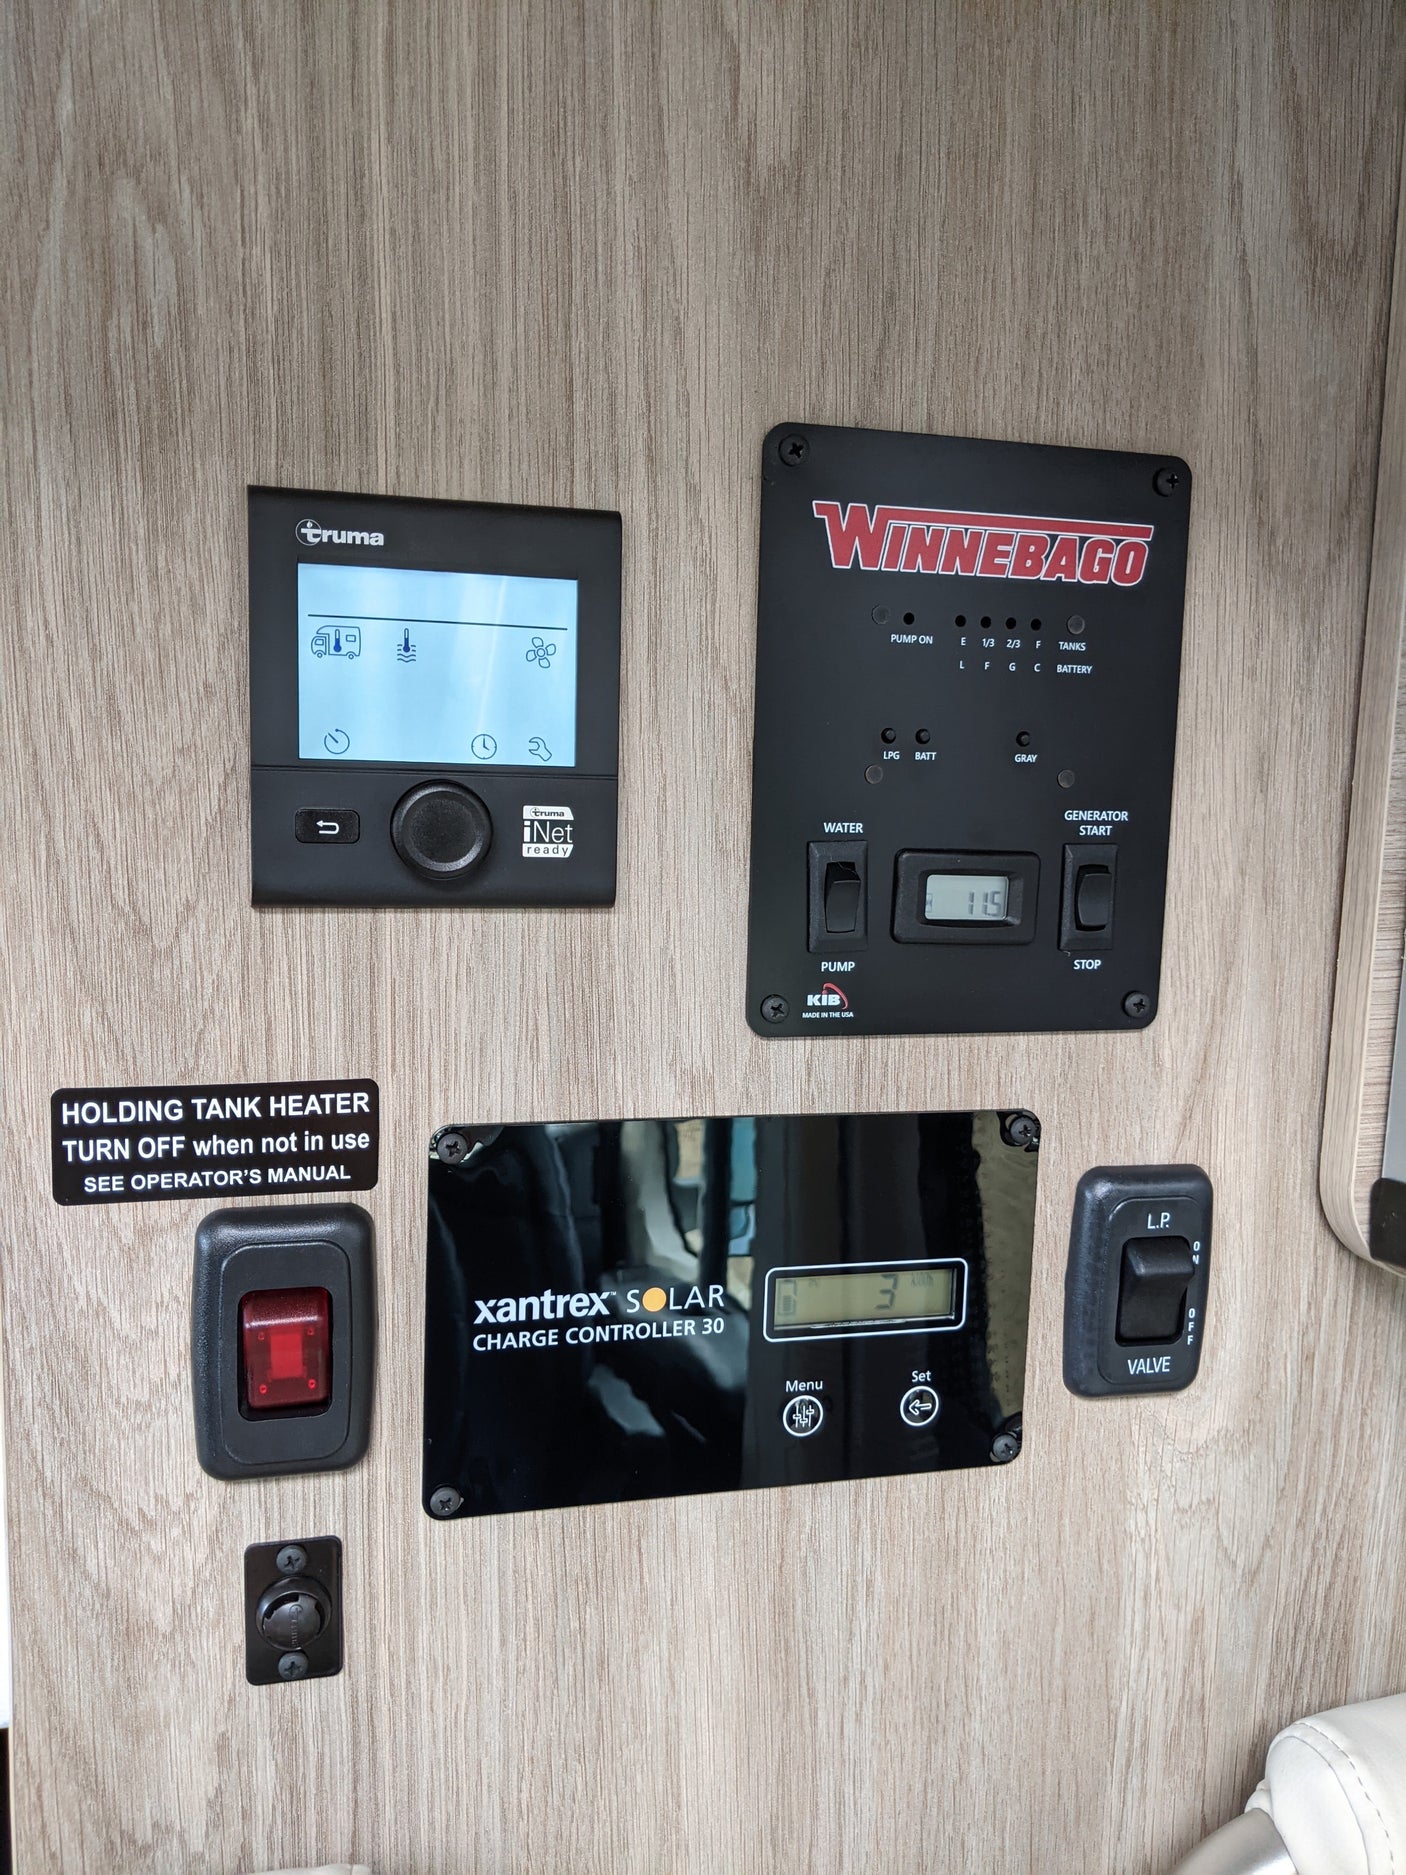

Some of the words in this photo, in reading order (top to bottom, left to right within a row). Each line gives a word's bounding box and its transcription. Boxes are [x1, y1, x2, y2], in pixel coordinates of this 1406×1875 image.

[297, 518, 385, 547] truma
[812, 500, 1154, 587] WINNEBAGO
[890, 633, 917, 645] PUMP
[918, 634, 934, 645] ON
[960, 637, 967, 646] E
[981, 638, 995, 648] 1/3
[1006, 639, 1021, 649] 2/3
[1035, 640, 1042, 649] F
[1058, 641, 1086, 651] TANKS
[959, 660, 965, 669] L
[984, 661, 990, 670] F
[1008, 662, 1016, 671] G
[1034, 663, 1041, 672] C
[1056, 664, 1093, 674] BATTERY
[883, 750, 900, 761] LPG
[914, 751, 937, 761] BATT
[1014, 753, 1038, 764] GRAY
[530, 807, 565, 818] truma
[1064, 809, 1129, 822] GENERATOR
[524, 820, 573, 843] iNet
[823, 822, 864, 834] WATER
[1078, 824, 1112, 837] START
[527, 845, 569, 857] ready
[820, 961, 855, 973] PUMP
[1073, 958, 1102, 971] STOP
[802, 1011, 820, 1019] MADE
[61, 1099, 184, 1125] HOLDING
[191, 1096, 262, 1121] TANK
[269, 1092, 370, 1117] HEATER
[62, 1139, 130, 1162] TURN
[137, 1136, 186, 1159] OFF
[192, 1135, 252, 1156] when
[261, 1131, 297, 1154] not
[304, 1131, 323, 1151] in
[331, 1131, 370, 1150] use
[84, 1176, 124, 1193] SEE
[130, 1169, 262, 1190] OPERATOR'S
[267, 1164, 351, 1183] MANUAL
[1147, 1212, 1171, 1229] L.P.
[875, 1274, 898, 1310] 3
[472, 1329, 559, 1351] CHARGE
[565, 1319, 696, 1345] CONTROLLER
[701, 1317, 725, 1335] 30
[1127, 1356, 1171, 1375] VALVE
[911, 1369, 932, 1383] Set
[785, 1379, 823, 1393] Menu
